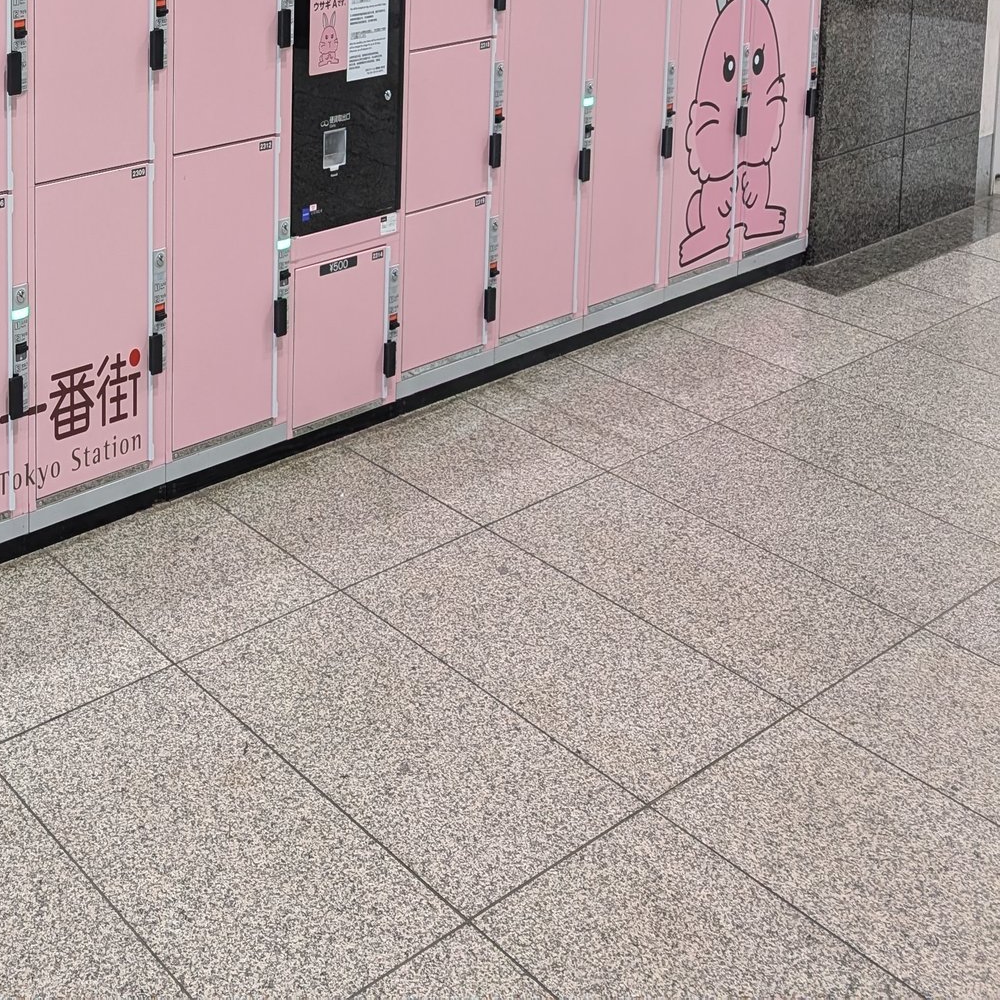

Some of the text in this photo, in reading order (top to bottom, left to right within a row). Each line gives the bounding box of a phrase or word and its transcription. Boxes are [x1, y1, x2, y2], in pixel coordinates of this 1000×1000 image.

[259, 141, 272, 151] 2312
[132, 167, 146, 178] 2309
[329, 259, 349, 273] ¥500
[71, 432, 142, 473] Station
